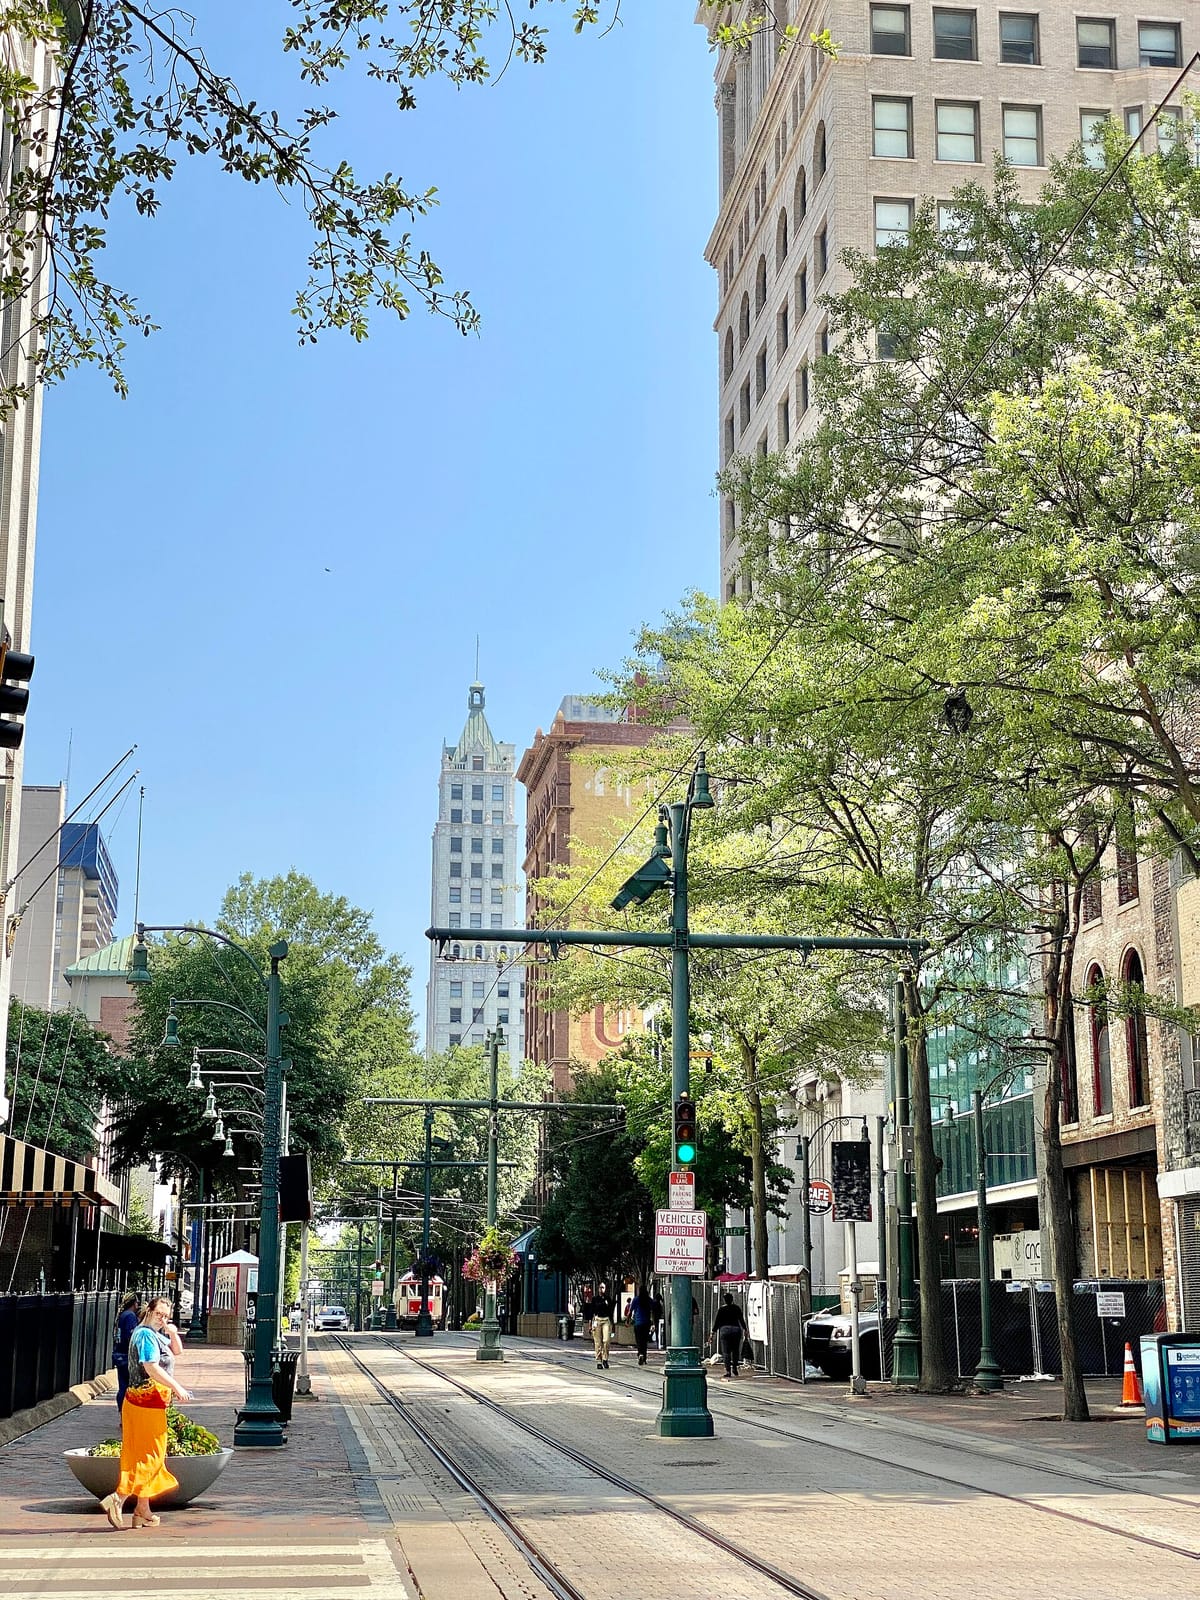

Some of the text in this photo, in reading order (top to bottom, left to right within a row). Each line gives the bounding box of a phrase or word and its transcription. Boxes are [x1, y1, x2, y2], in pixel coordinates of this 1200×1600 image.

[808, 1188, 829, 1200] CAFE
[660, 1214, 702, 1225] VEHICLES
[658, 1226, 703, 1236] PROHIBITED
[675, 1238, 686, 1247] ON
[669, 1248, 690, 1257] MALL
